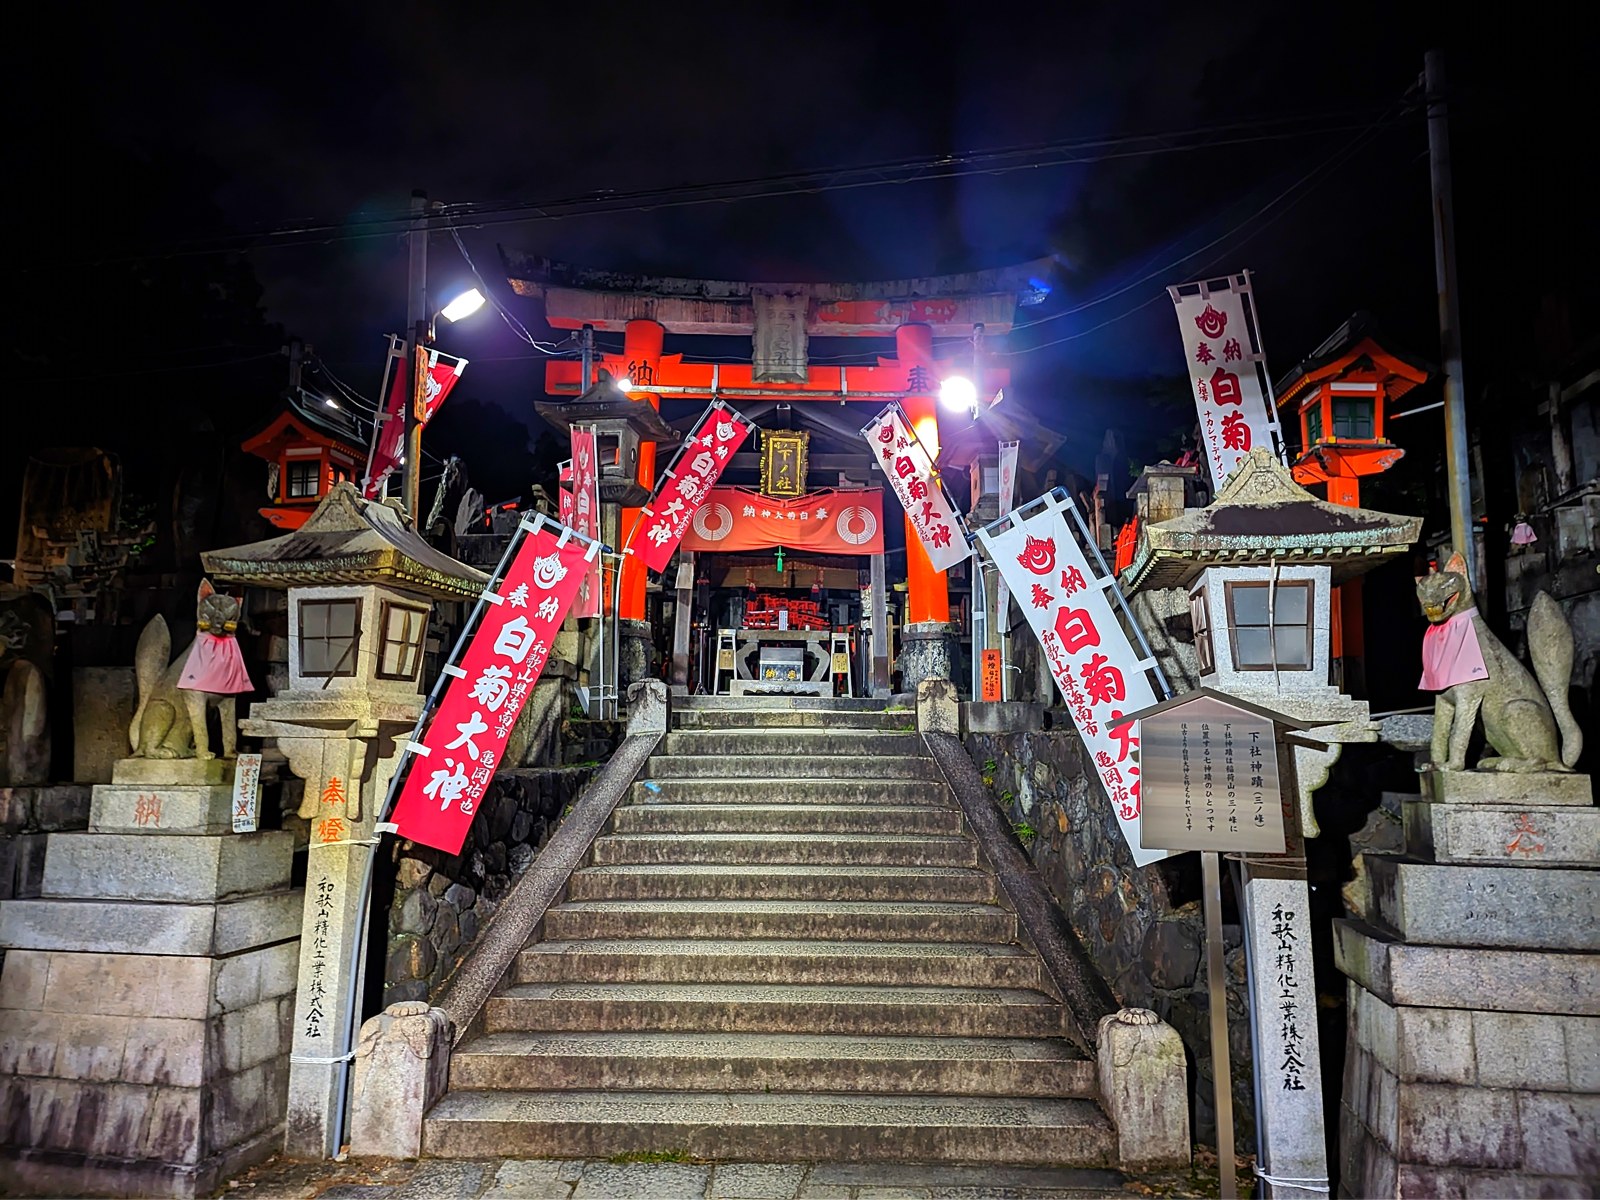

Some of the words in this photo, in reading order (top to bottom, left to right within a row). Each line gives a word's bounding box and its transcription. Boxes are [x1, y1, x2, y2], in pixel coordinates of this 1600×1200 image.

[906, 365, 929, 392] 奉
[1196, 338, 1242, 365] 奉納
[1197, 377, 1208, 402] 大垣市
[1204, 411, 1225, 480] ナカシマ・デザイン
[1209, 367, 1252, 463] 白菊
[647, 451, 714, 548] 白菊大神
[777, 449, 793, 489] 下ノ社
[895, 455, 951, 548] 白菊大神
[506, 582, 559, 623] 奉納
[1031, 565, 1088, 610] 奉納
[423, 615, 536, 811] 白菊大神
[494, 640, 547, 739] 和歌山県海南市
[1042, 630, 1098, 738] 和歌山県海南市
[1095, 751, 1138, 820] 亀岡祐也
[460, 750, 495, 816] 亀岡祐也
[1202, 723, 1215, 833] 位置する七神蹟のひとつです
[305, 877, 334, 1038] 和歌山精化工業株式会社
[1271, 903, 1305, 1091] 和歌山精化工業株式会社
